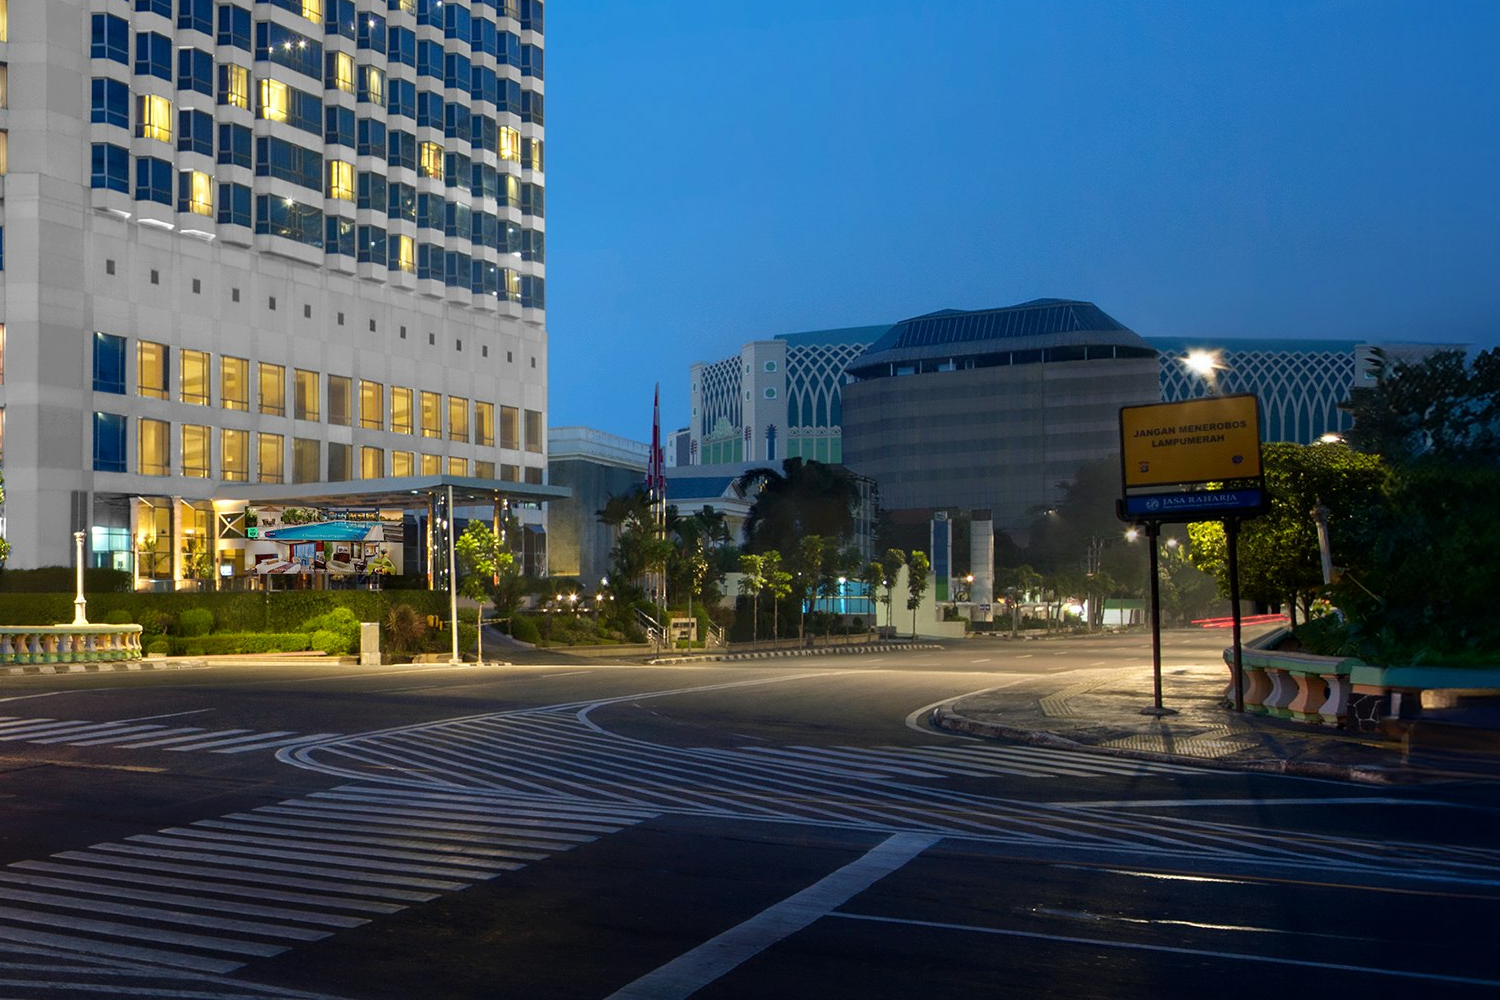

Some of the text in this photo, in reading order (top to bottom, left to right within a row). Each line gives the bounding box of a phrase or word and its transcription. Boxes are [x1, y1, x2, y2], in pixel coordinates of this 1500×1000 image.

[1133, 420, 1247, 438] JANGAN MENEROBOS
[1152, 434, 1225, 448] LAMPUMERAH
[1162, 497, 1186, 506] JASA
[1188, 494, 1237, 503] RAHARJA
